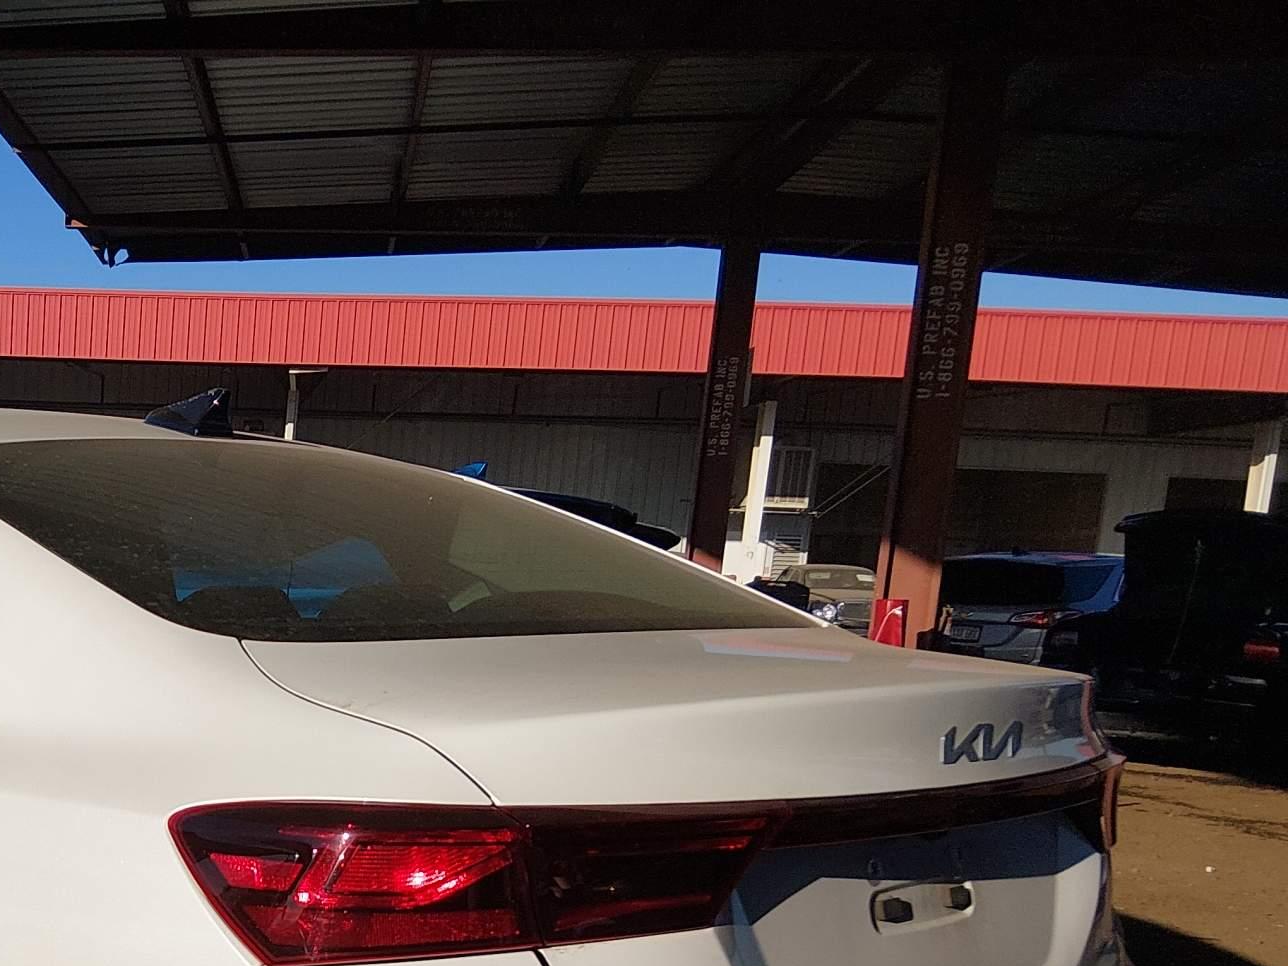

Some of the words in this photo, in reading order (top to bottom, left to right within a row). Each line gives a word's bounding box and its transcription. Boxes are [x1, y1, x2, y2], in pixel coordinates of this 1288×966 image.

[923, 285, 945, 355] PREFAB
[934, 246, 950, 275] INC
[935, 243, 969, 398] 1-866-799-0969
[940, 721, 1024, 765] KIA
